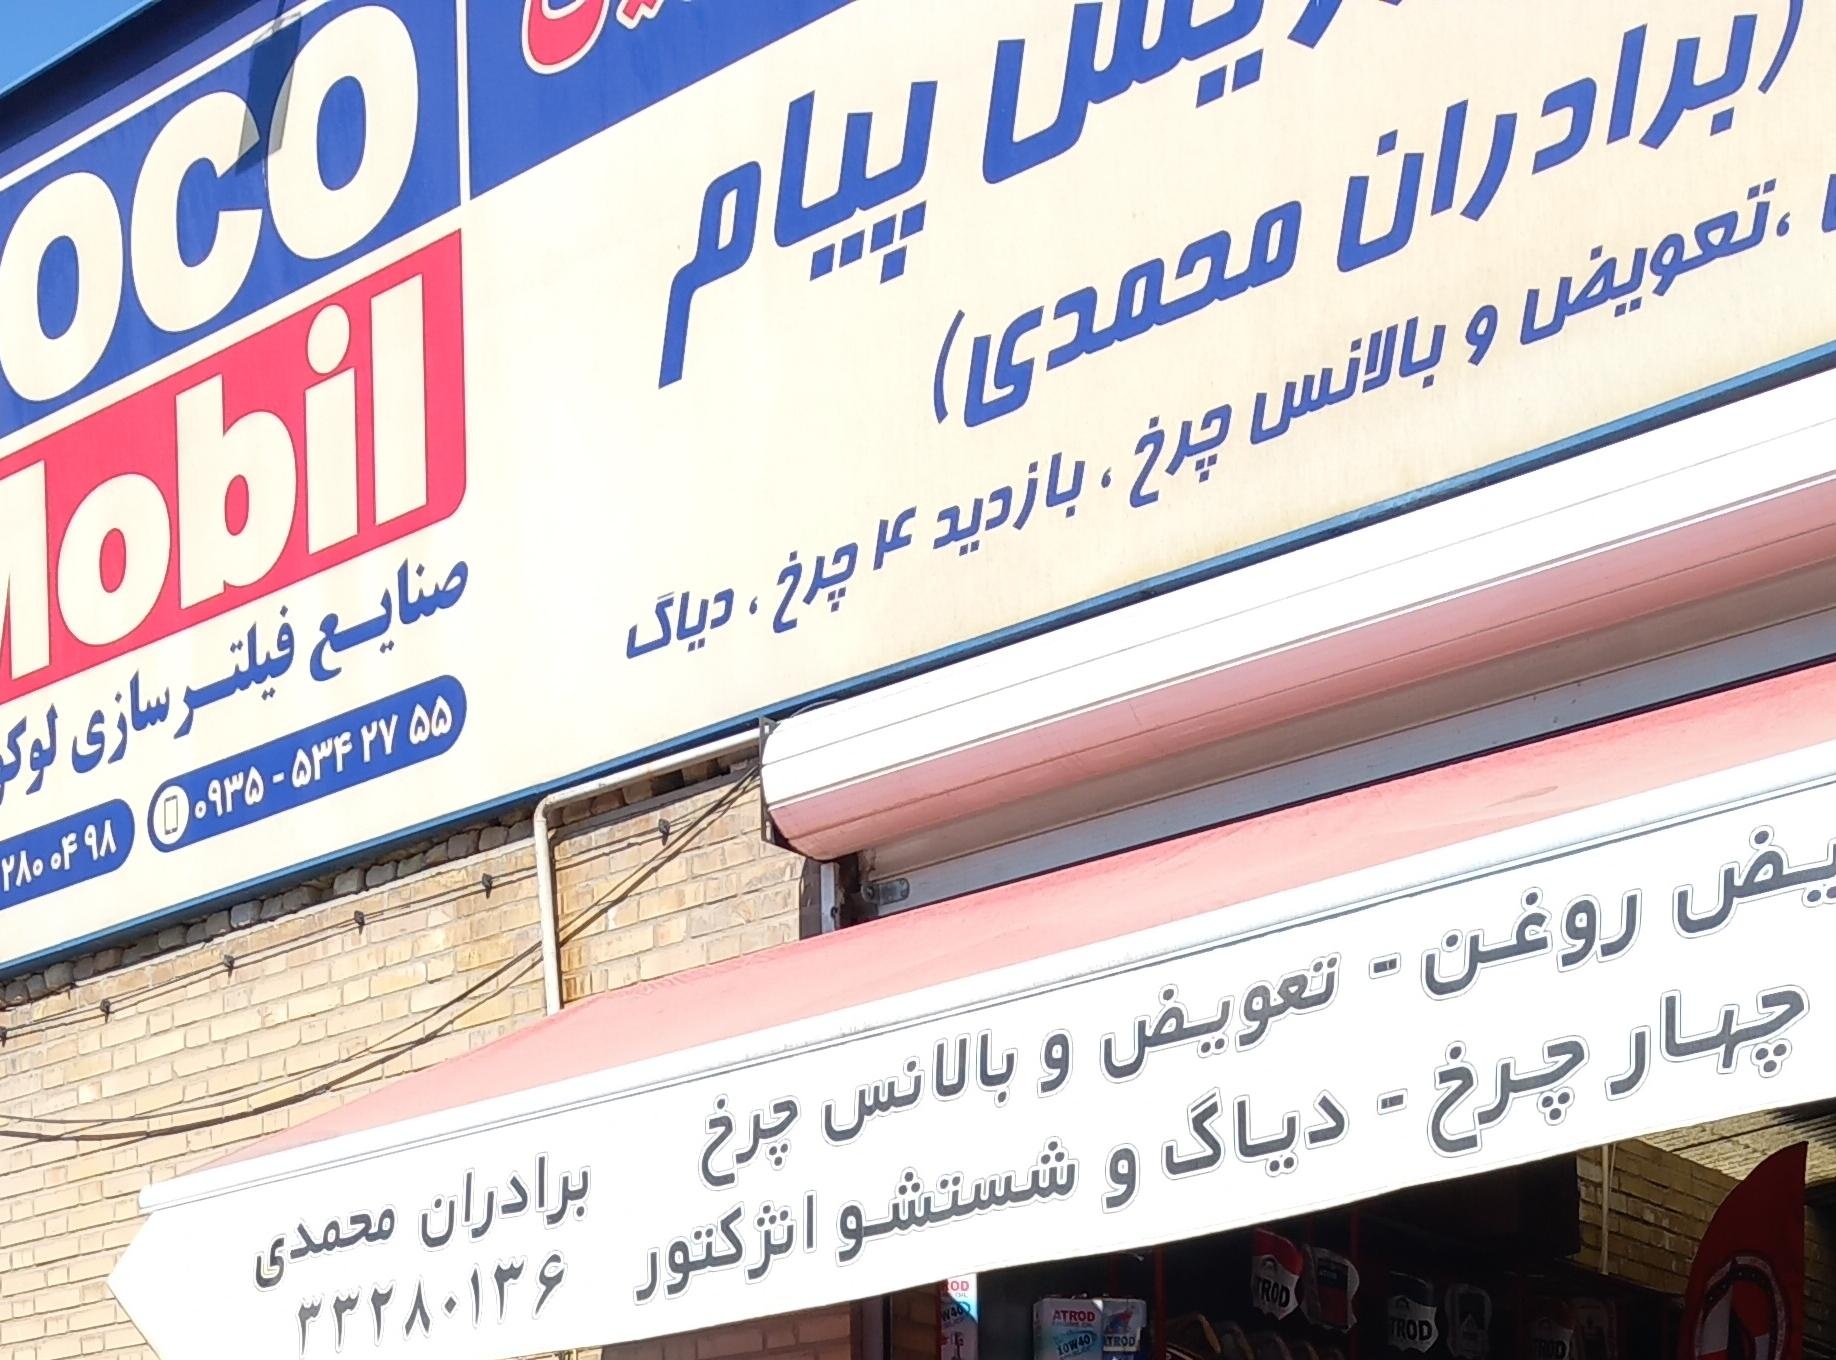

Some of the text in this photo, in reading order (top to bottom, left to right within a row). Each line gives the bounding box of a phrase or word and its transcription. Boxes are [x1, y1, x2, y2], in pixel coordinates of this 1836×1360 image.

[659, 80, 938, 389] پیام
[1249, 315, 1447, 445] بالانس
[1464, 304, 1499, 366] و
[932, 452, 1086, 556] بازدید
[1129, 404, 1233, 508] چرخ
[308, 557, 469, 682] صنایع
[625, 590, 736, 660] دیاگ
[772, 542, 859, 634] چرخ
[0, 703, 59, 800] لوک
[1425, 890, 1639, 996] روغن
[1039, 1032, 1070, 1093] و
[1102, 956, 1338, 1080] تعویض
[1608, 989, 1806, 1097] چهار
[823, 1030, 1015, 1143] بالانس
[1164, 1091, 1346, 1175] دیاگ
[1430, 1038, 1586, 1153] چرخ
[700, 1094, 799, 1187] چرخ
[1104, 1147, 1137, 1209] و
[254, 1155, 590, 1290] برادران محمدی
[635, 1195, 815, 1303] انژکتور
[837, 1139, 1077, 1263] شستشو
[1053, 1310, 1095, 1322] ATROD
